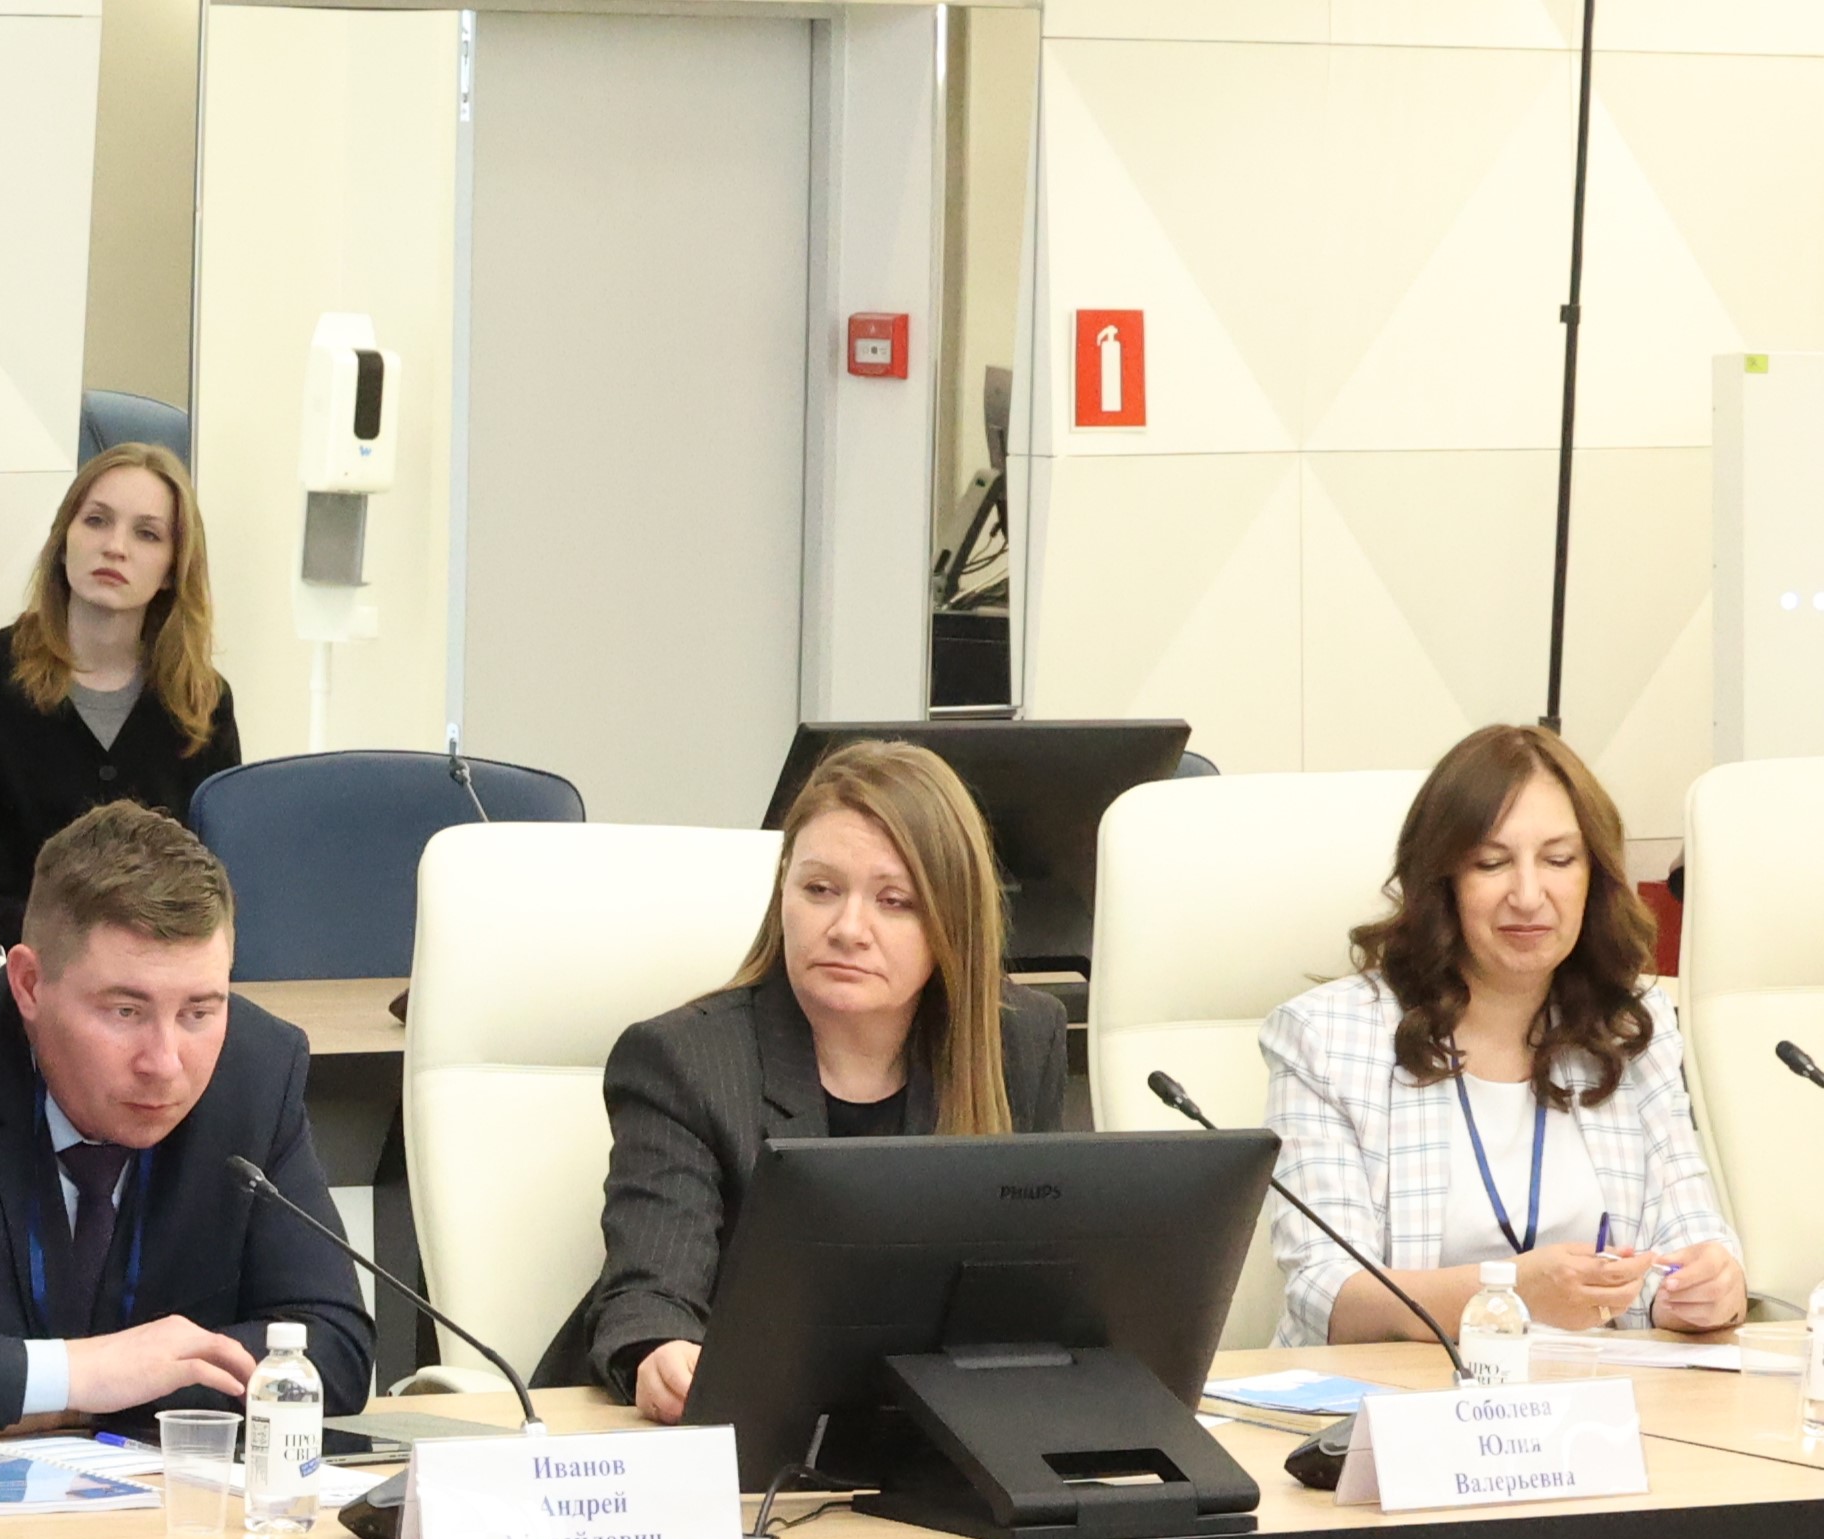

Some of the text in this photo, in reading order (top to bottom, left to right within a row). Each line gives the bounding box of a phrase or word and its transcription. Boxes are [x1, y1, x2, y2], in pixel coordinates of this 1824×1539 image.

[997, 1185, 1061, 1200] PHILIPS
[1455, 1399, 1552, 1422] Соболева
[1478, 1433, 1541, 1456] Юлия
[533, 1456, 626, 1479] Иванов
[1455, 1471, 1576, 1496] Валерьевна
[541, 1491, 627, 1521] Андрей
